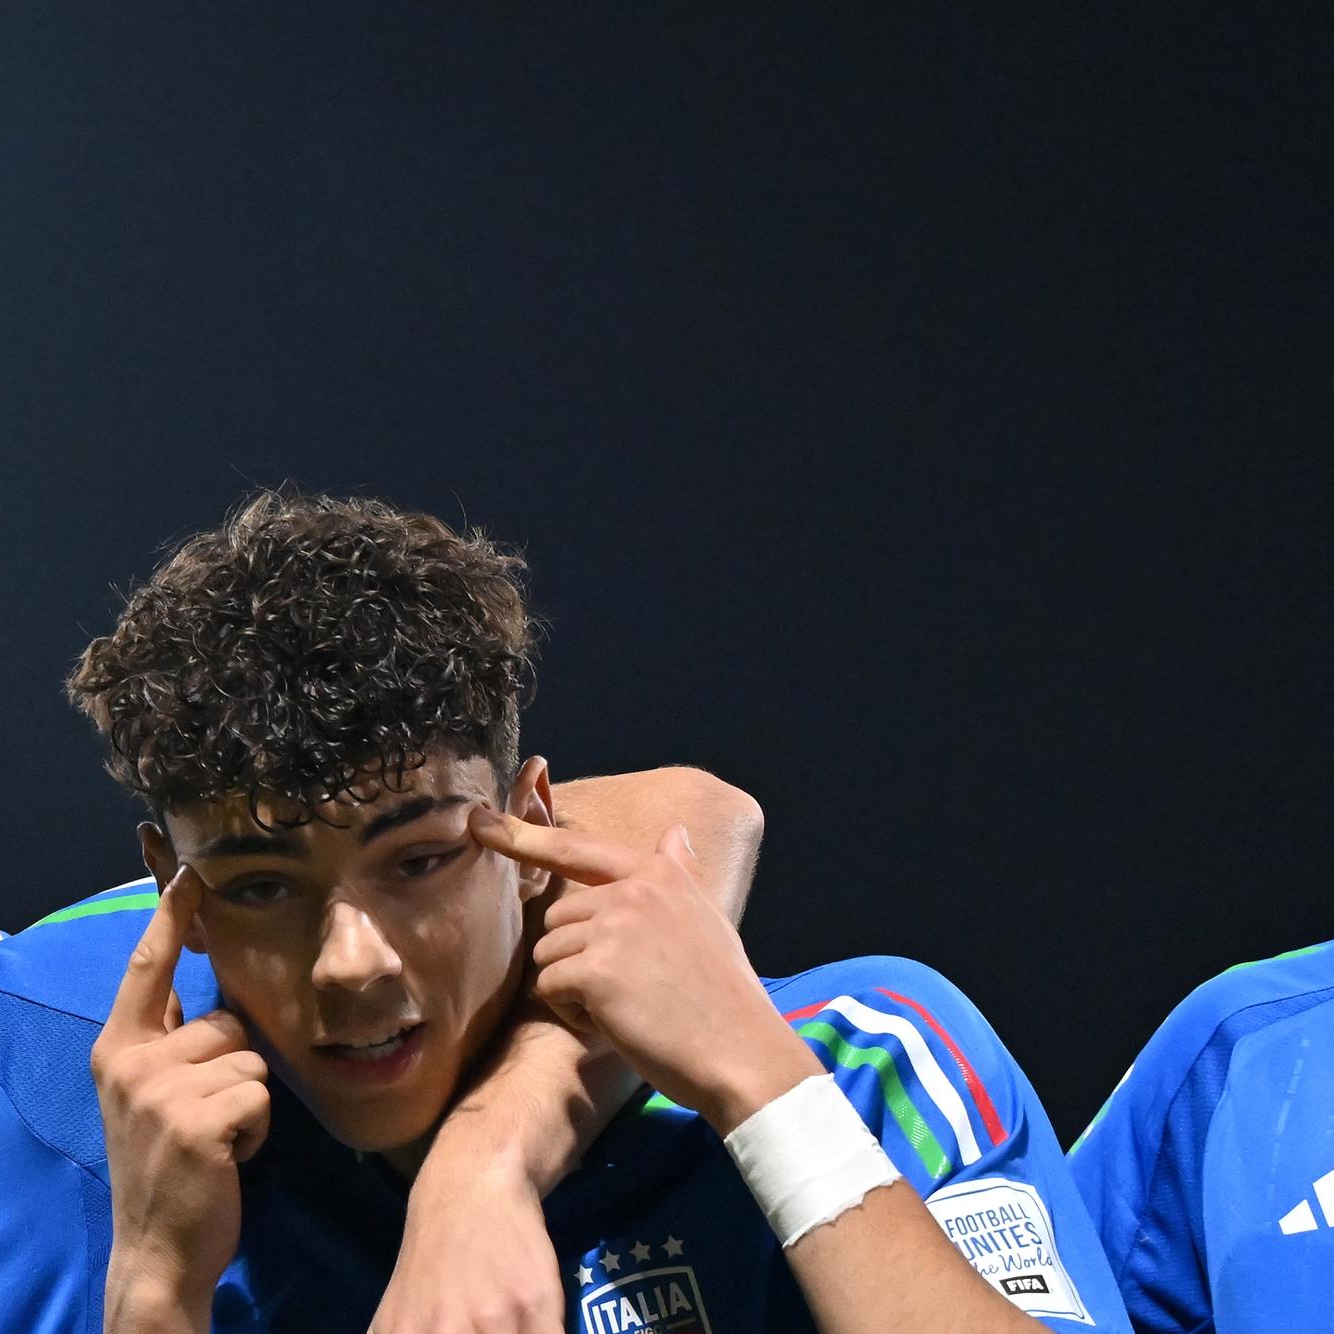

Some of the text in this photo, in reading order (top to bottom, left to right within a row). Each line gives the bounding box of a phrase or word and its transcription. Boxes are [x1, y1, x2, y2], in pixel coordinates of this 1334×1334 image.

[944, 1203, 1031, 1238] FOOTBALL
[954, 1221, 1043, 1261] UNITES
[971, 1247, 1054, 1277] he World
[1006, 1278, 1044, 1292] FIFA
